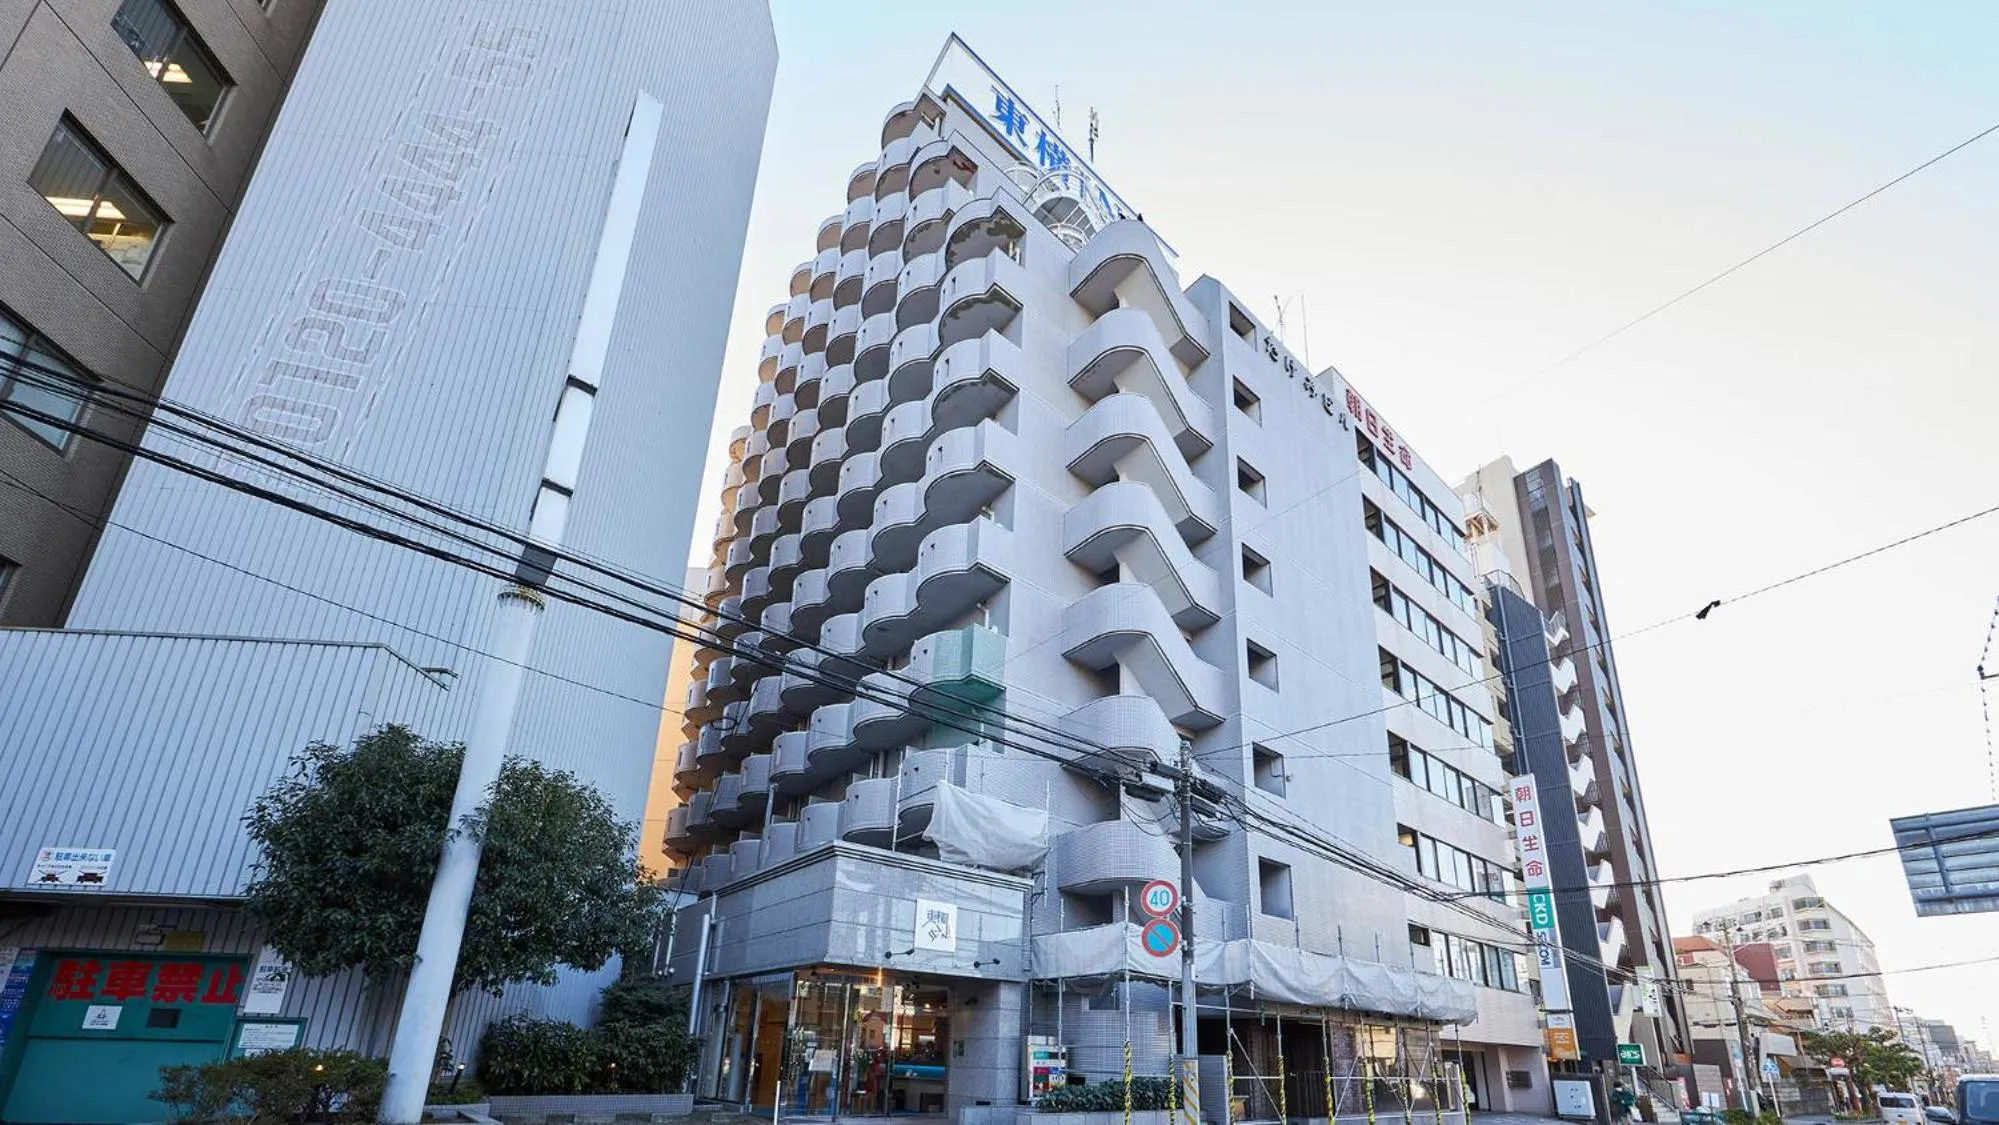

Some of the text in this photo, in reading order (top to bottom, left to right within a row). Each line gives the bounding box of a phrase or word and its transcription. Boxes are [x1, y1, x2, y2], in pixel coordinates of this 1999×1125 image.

[1345, 388, 1412, 471] 朝日生命
[1515, 785, 1543, 877] 朝日生命
[1150, 889, 1170, 907] 40
[1533, 893, 1548, 925] CKD
[49, 959, 244, 1004] 駐車禁止
